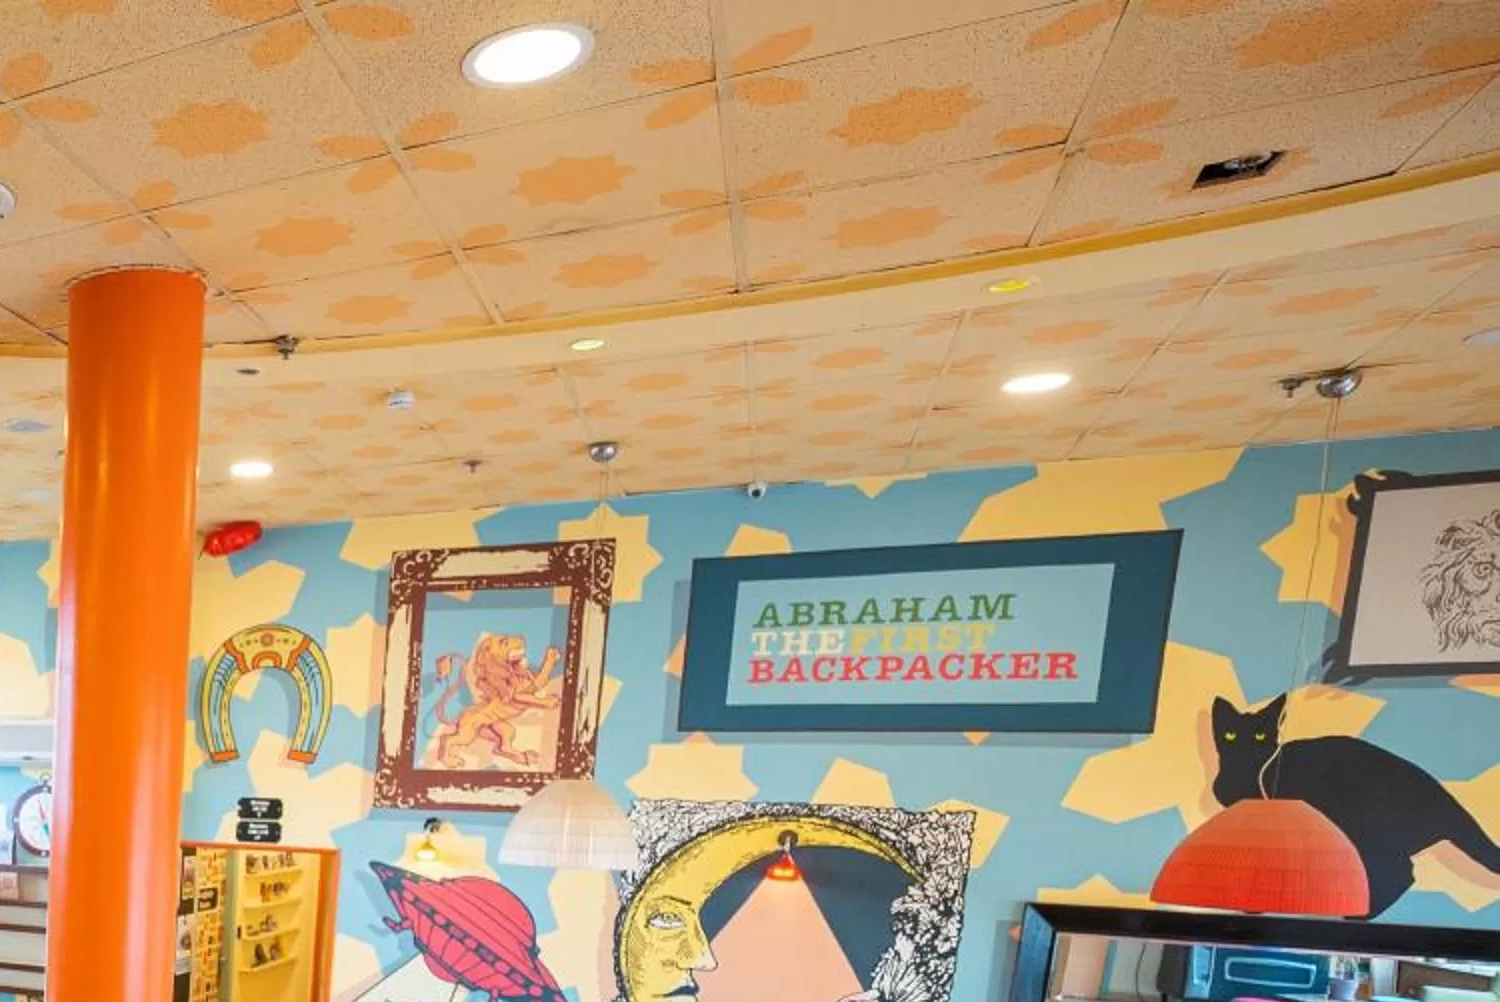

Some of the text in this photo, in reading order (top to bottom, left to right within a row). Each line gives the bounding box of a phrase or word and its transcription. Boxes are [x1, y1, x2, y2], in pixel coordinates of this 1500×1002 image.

[752, 593, 1017, 628] ABRAHAM
[751, 623, 996, 657] THE FIRST
[747, 652, 1078, 684] BACKPACKER
